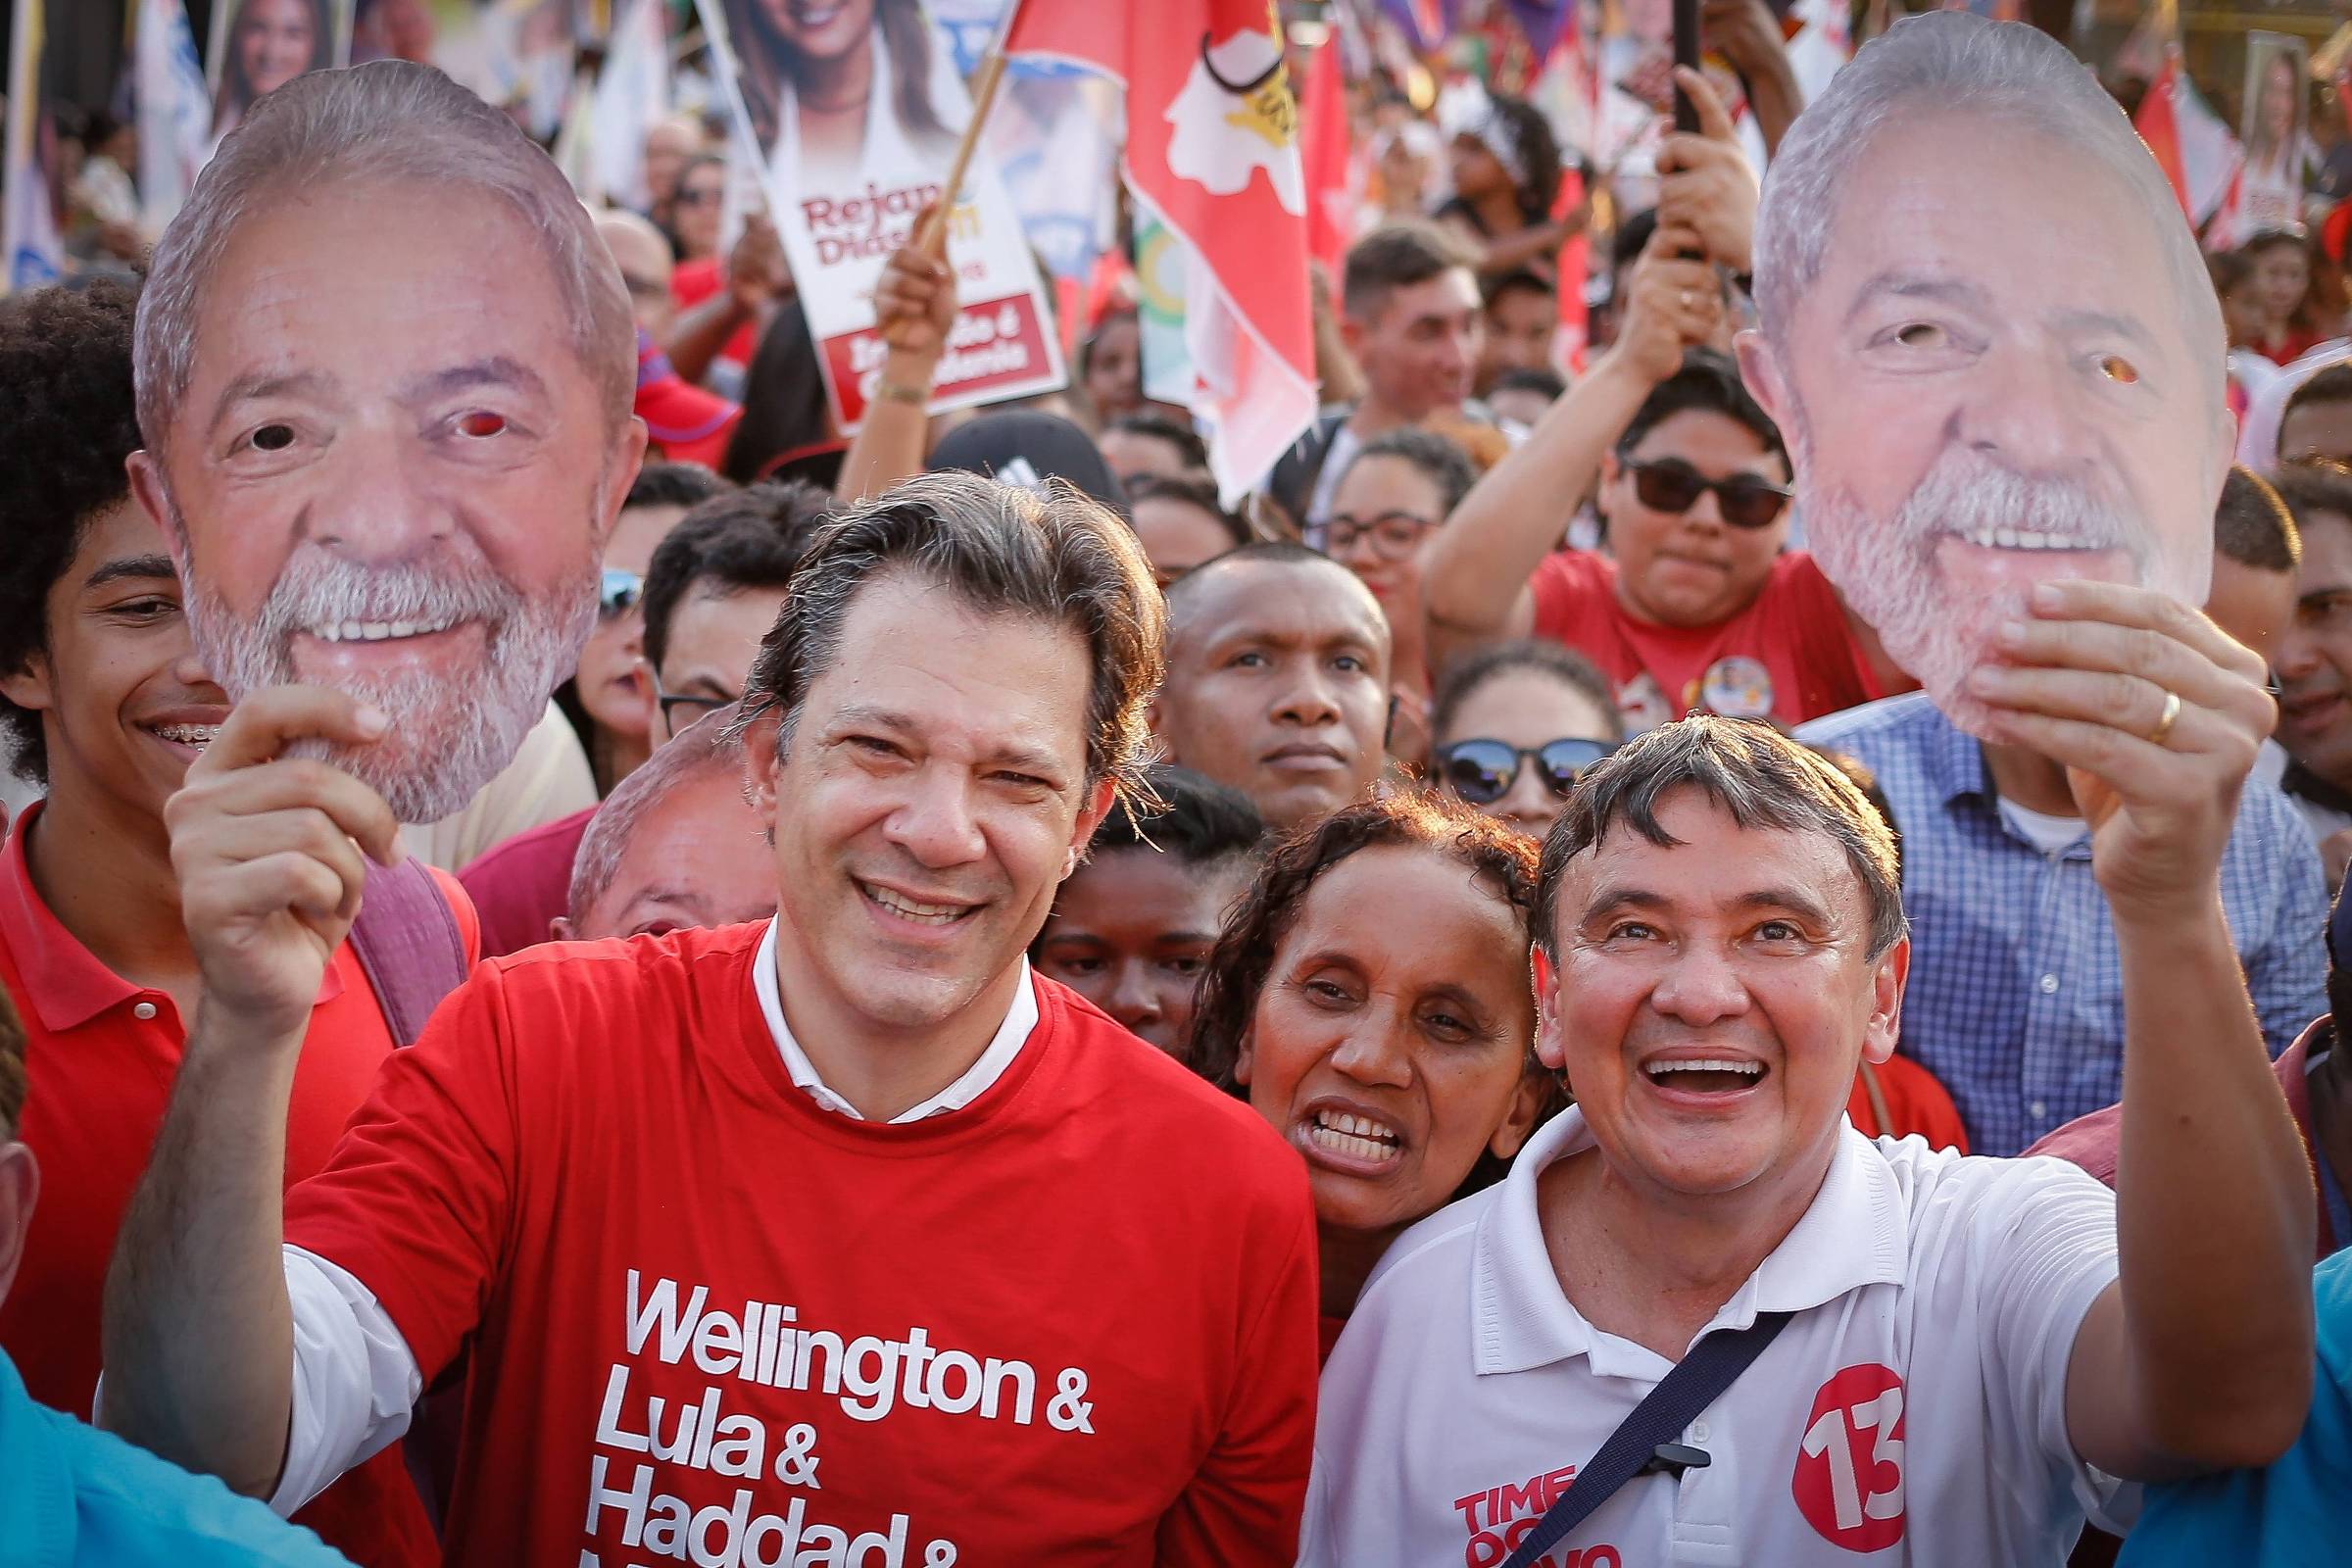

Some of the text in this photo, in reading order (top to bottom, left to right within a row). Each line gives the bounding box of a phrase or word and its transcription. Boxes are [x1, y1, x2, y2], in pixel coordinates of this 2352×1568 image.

[801, 181, 943, 235] Rejan
[625, 1268, 1097, 1435] Wellington &
[595, 1363, 822, 1490] Lula &
[1802, 1387, 1906, 1531] 13
[584, 1453, 910, 1568] Haddad
[1453, 1464, 1577, 1537] TIME
